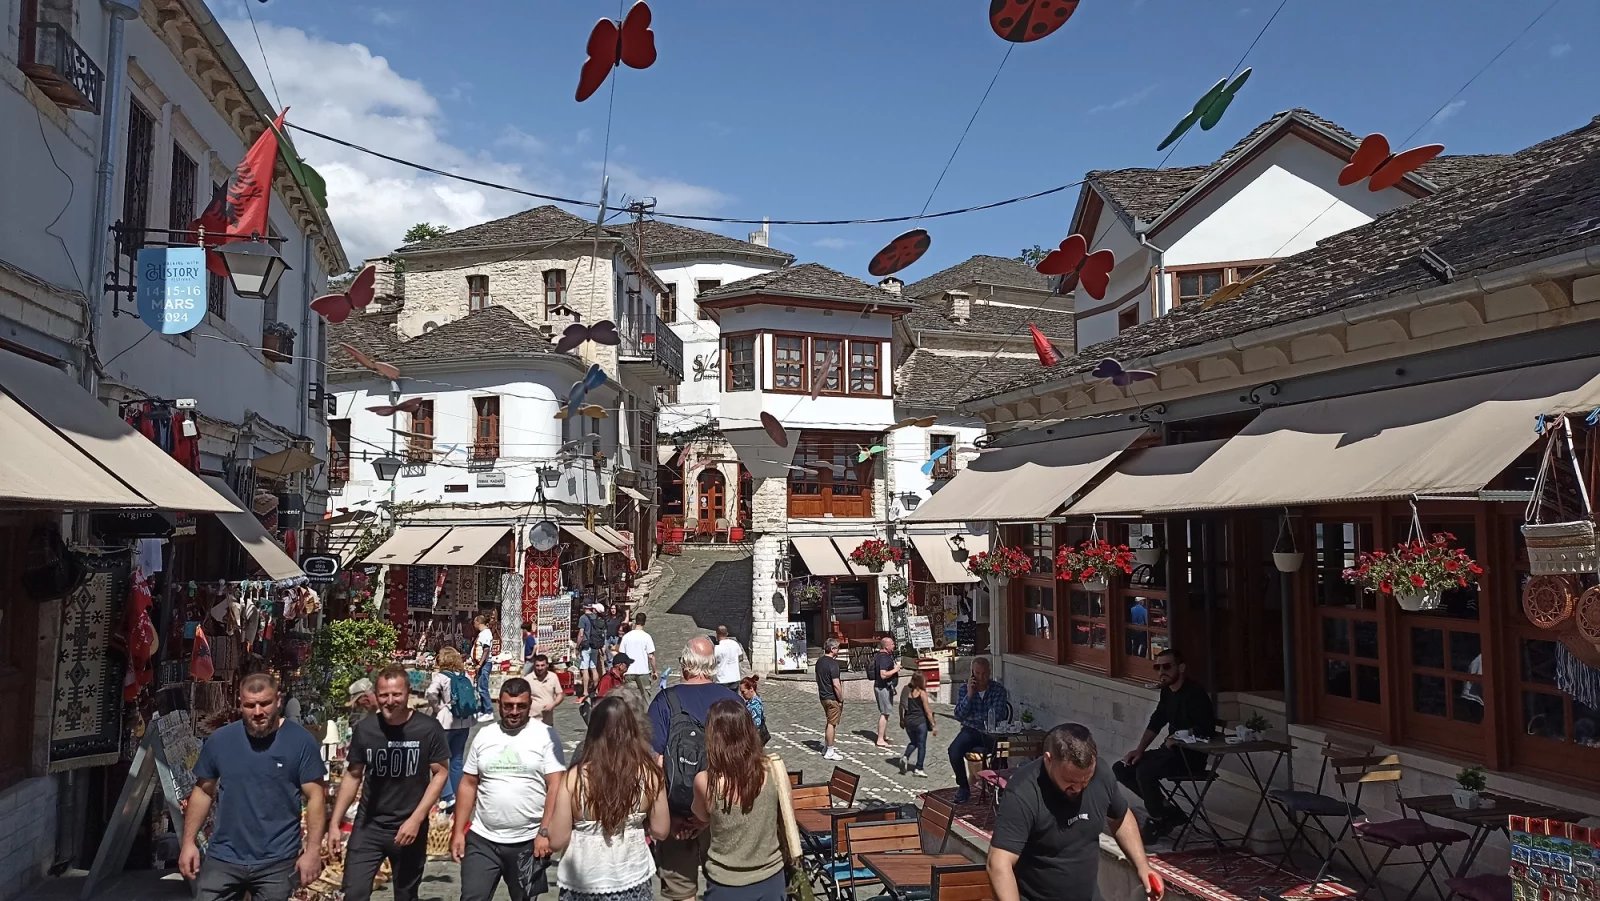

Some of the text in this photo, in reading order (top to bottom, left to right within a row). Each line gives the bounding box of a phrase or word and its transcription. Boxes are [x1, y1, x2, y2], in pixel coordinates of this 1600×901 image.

[145, 263, 200, 281] HISTORY
[146, 286, 201, 296] 14-15-16
[151, 299, 194, 310] MARS
[157, 312, 188, 322] 2024
[366, 748, 420, 777] ICON
